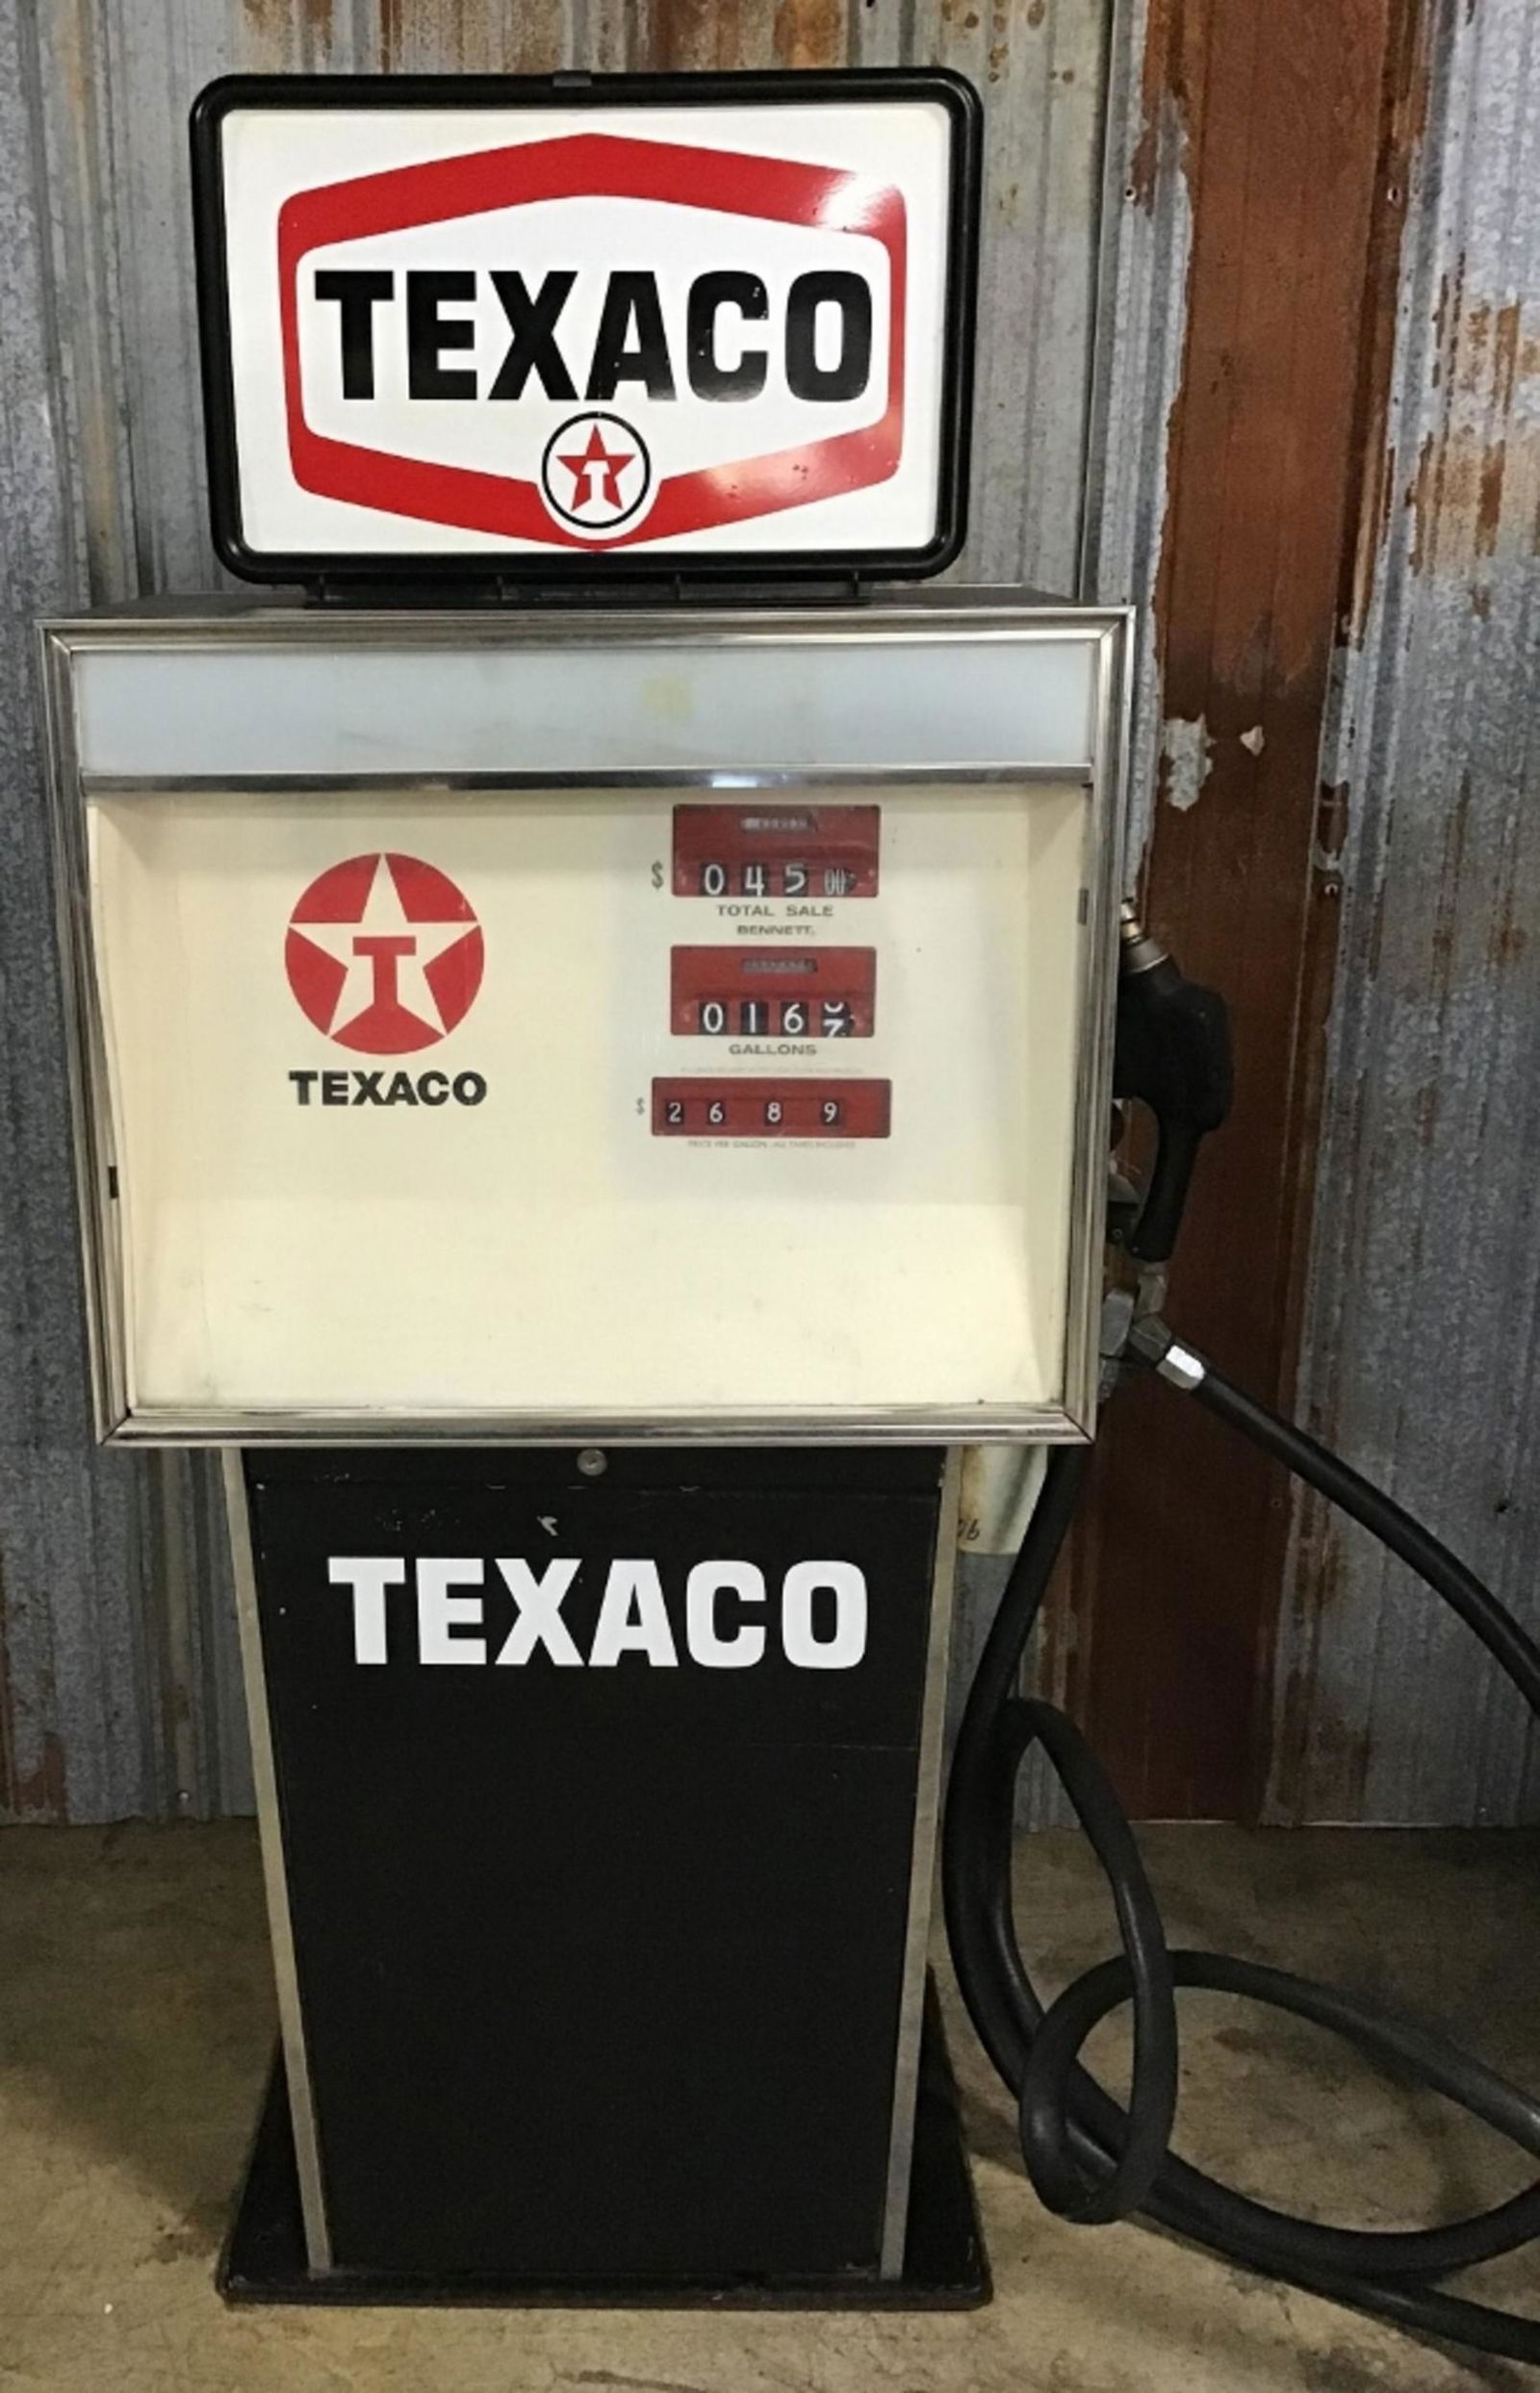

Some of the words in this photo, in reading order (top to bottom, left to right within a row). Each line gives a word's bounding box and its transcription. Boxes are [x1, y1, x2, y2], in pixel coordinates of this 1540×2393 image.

[314, 269, 873, 402] TEXACO
[651, 861, 665, 890] $
[717, 904, 775, 917] TOTAL
[785, 904, 834, 917] SALE
[729, 1043, 817, 1056] GALLONS
[289, 1069, 487, 1107] TEXACO
[327, 1556, 869, 1670] TEXACO
